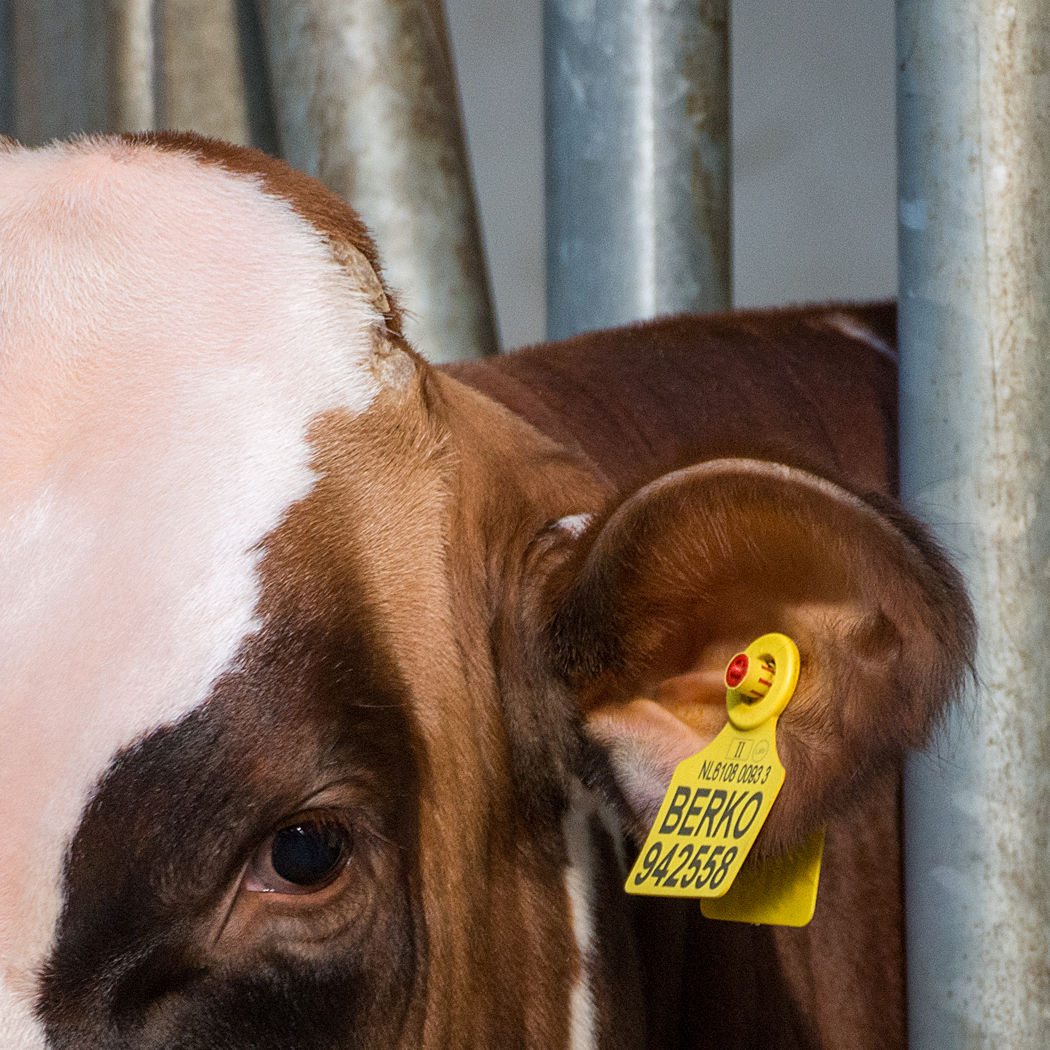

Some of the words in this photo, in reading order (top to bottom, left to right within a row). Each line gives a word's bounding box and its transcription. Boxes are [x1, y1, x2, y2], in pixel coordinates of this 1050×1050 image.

[698, 760, 739, 783] NL6108
[737, 764, 763, 784] 0093
[761, 765, 772, 785] 3
[659, 786, 763, 840] BERKO
[634, 842, 738, 890] 942558
